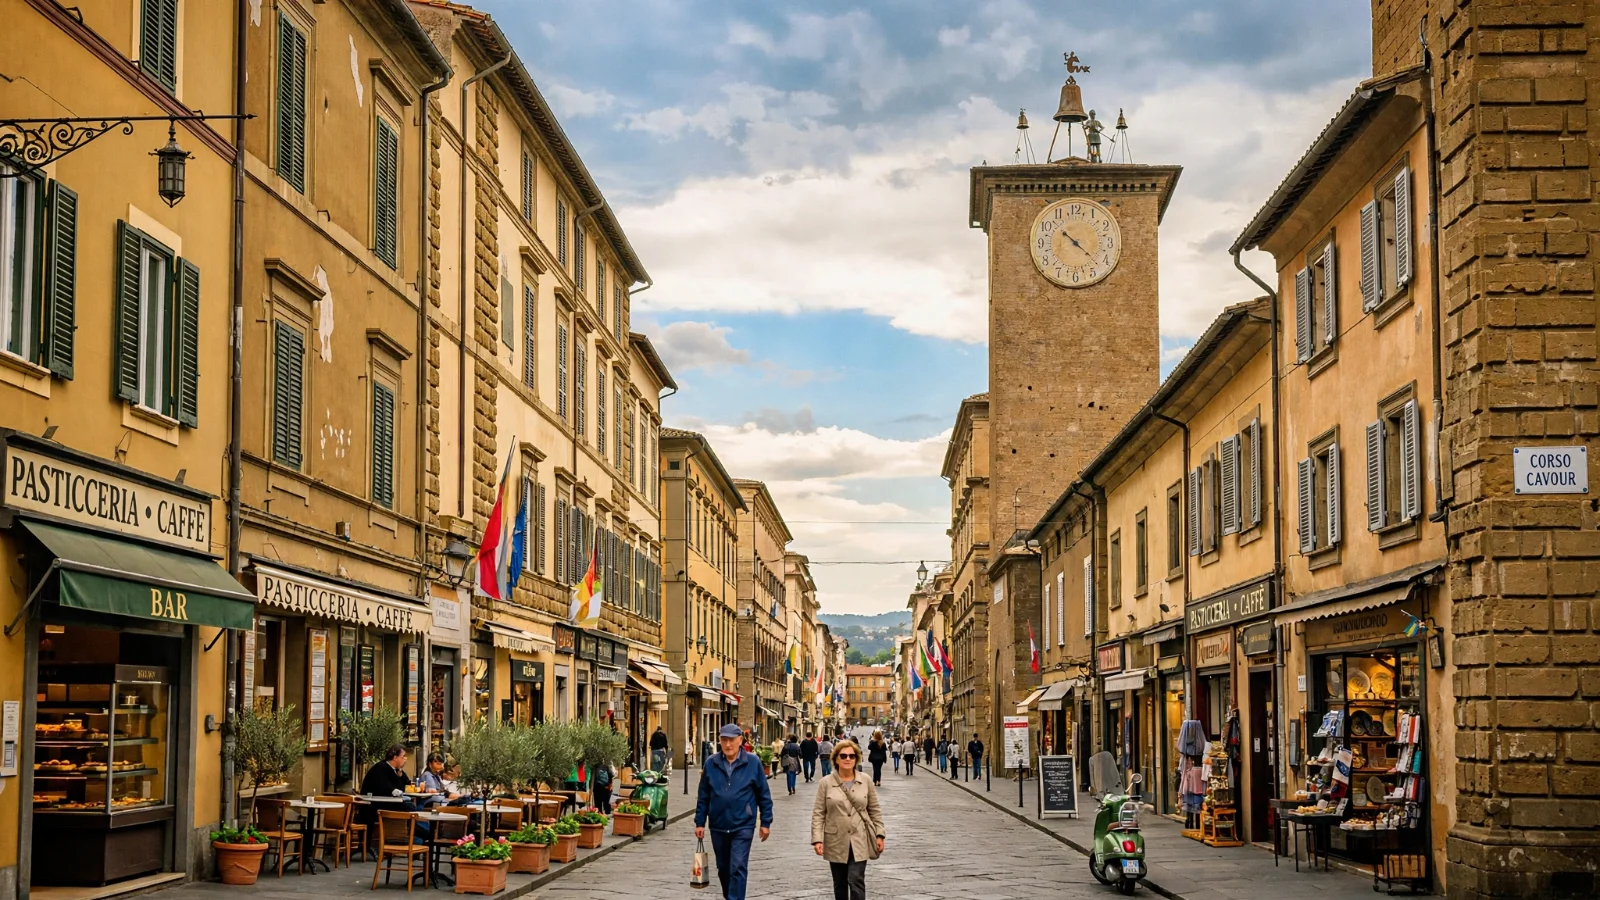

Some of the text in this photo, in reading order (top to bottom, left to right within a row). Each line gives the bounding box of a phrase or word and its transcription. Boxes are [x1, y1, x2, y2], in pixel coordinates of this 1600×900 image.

[1055, 208, 1062, 219] 11
[1071, 204, 1081, 215] 12
[1091, 208, 1094, 218] 1
[1041, 221, 1052, 232] 10
[1102, 220, 1110, 231] 2
[1037, 238, 1044, 249] 9
[1107, 238, 1114, 248] 3
[1042, 255, 1048, 266] 8
[1055, 267, 1062, 278] 7
[1072, 272, 1079, 283] 6
[1090, 268, 1096, 278] 5
[1530, 454, 1571, 468] CORSO
[1526, 472, 1576, 486] CAVOUR
[11, 456, 205, 542] PASTICCERIA CAFFÈ
[264, 577, 359, 619] PASTICCERIA
[151, 588, 188, 620] BAR
